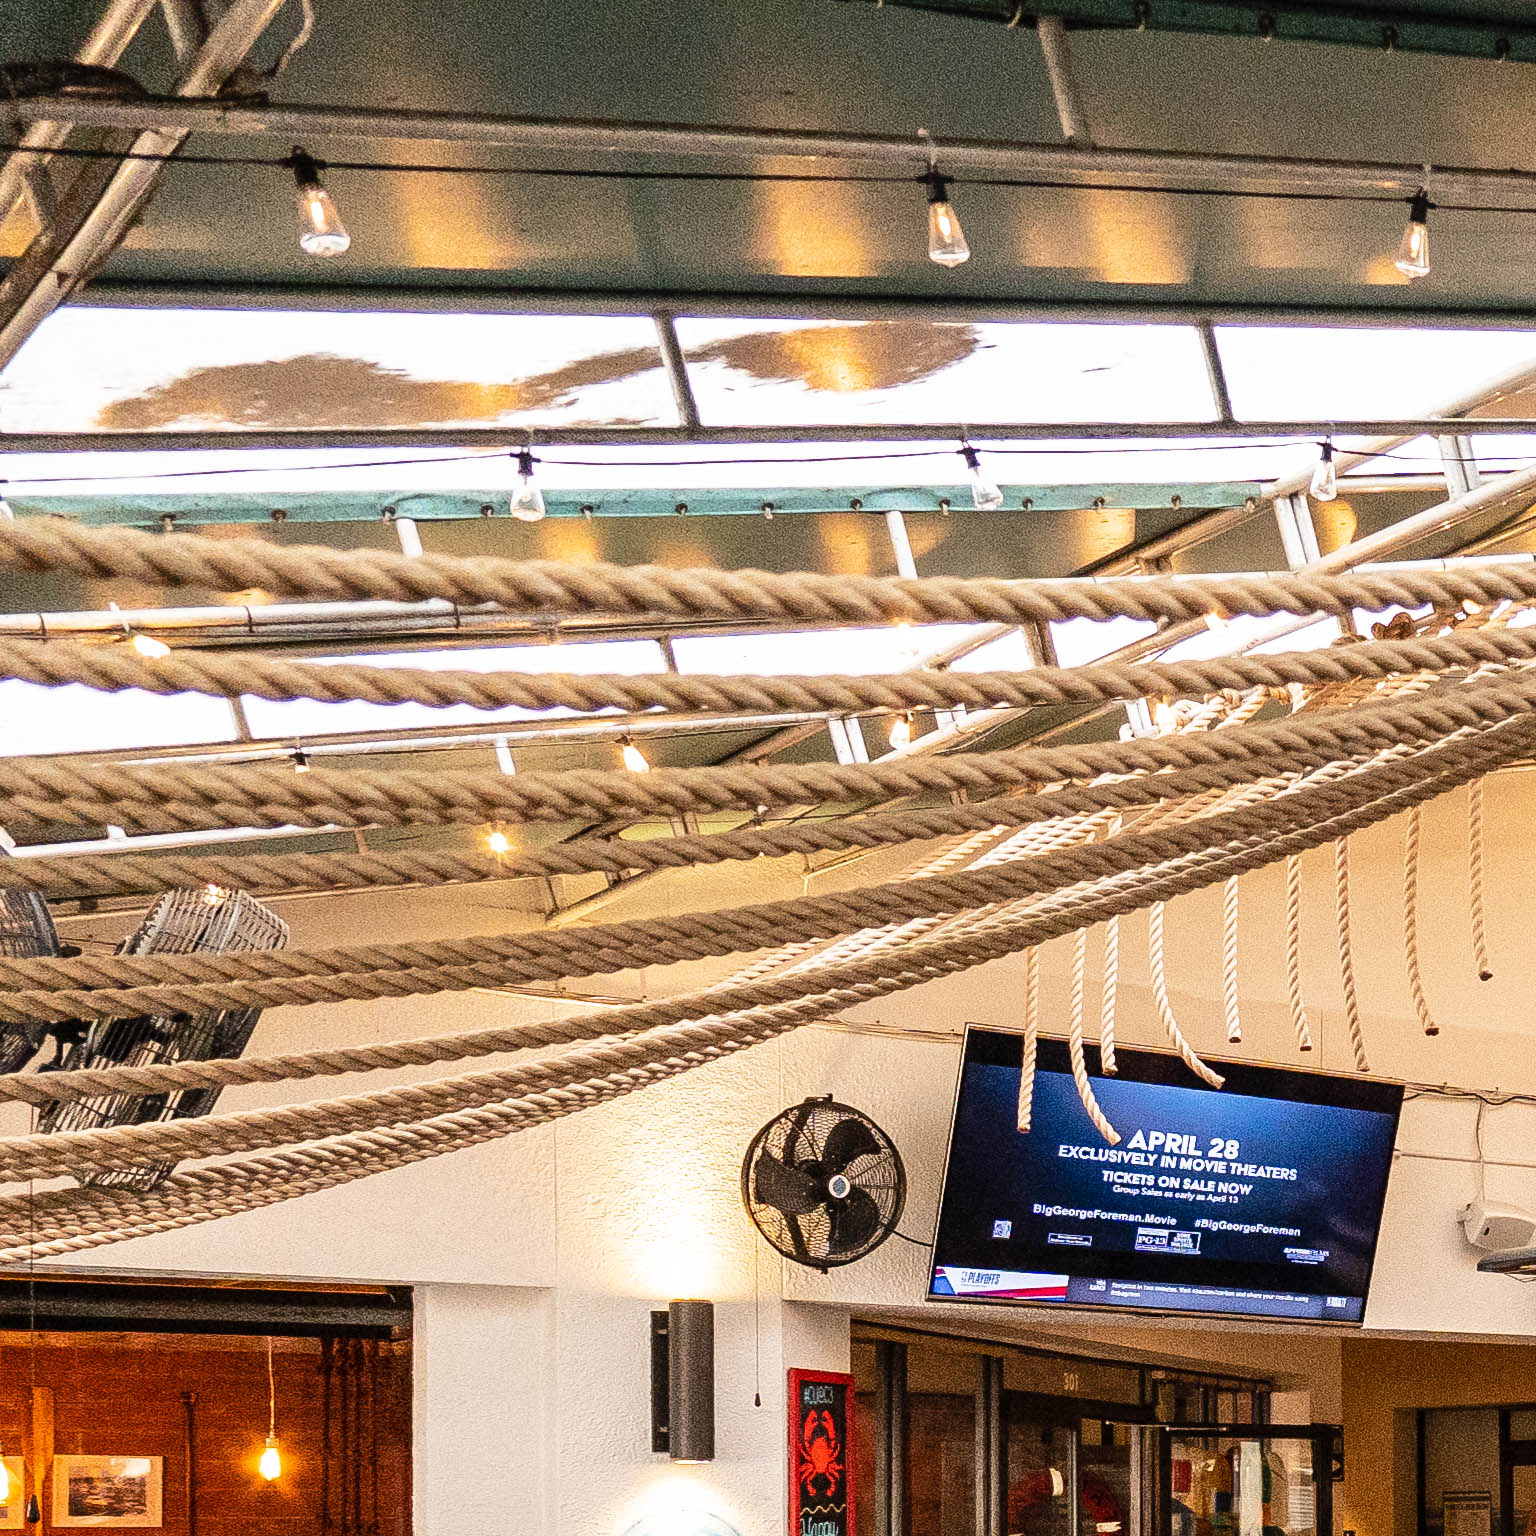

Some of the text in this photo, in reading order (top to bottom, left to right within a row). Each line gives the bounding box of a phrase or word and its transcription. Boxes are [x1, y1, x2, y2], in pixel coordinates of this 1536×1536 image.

[1127, 1128, 1240, 1160] APRIL 28
[1058, 1144, 1298, 1181] EXCLUSIVELY IN MOVIE THEATERS
[1102, 1169, 1254, 1196] TICKETS ON SALE NOW
[1112, 1184, 1140, 1196] Group
[1228, 1195, 1239, 1204] 13
[1032, 1203, 1177, 1226] BigGeorgeForeman.Movie
[1194, 1218, 1301, 1237] #BigGeorgeForeman
[1138, 1235, 1167, 1245] PG-13
